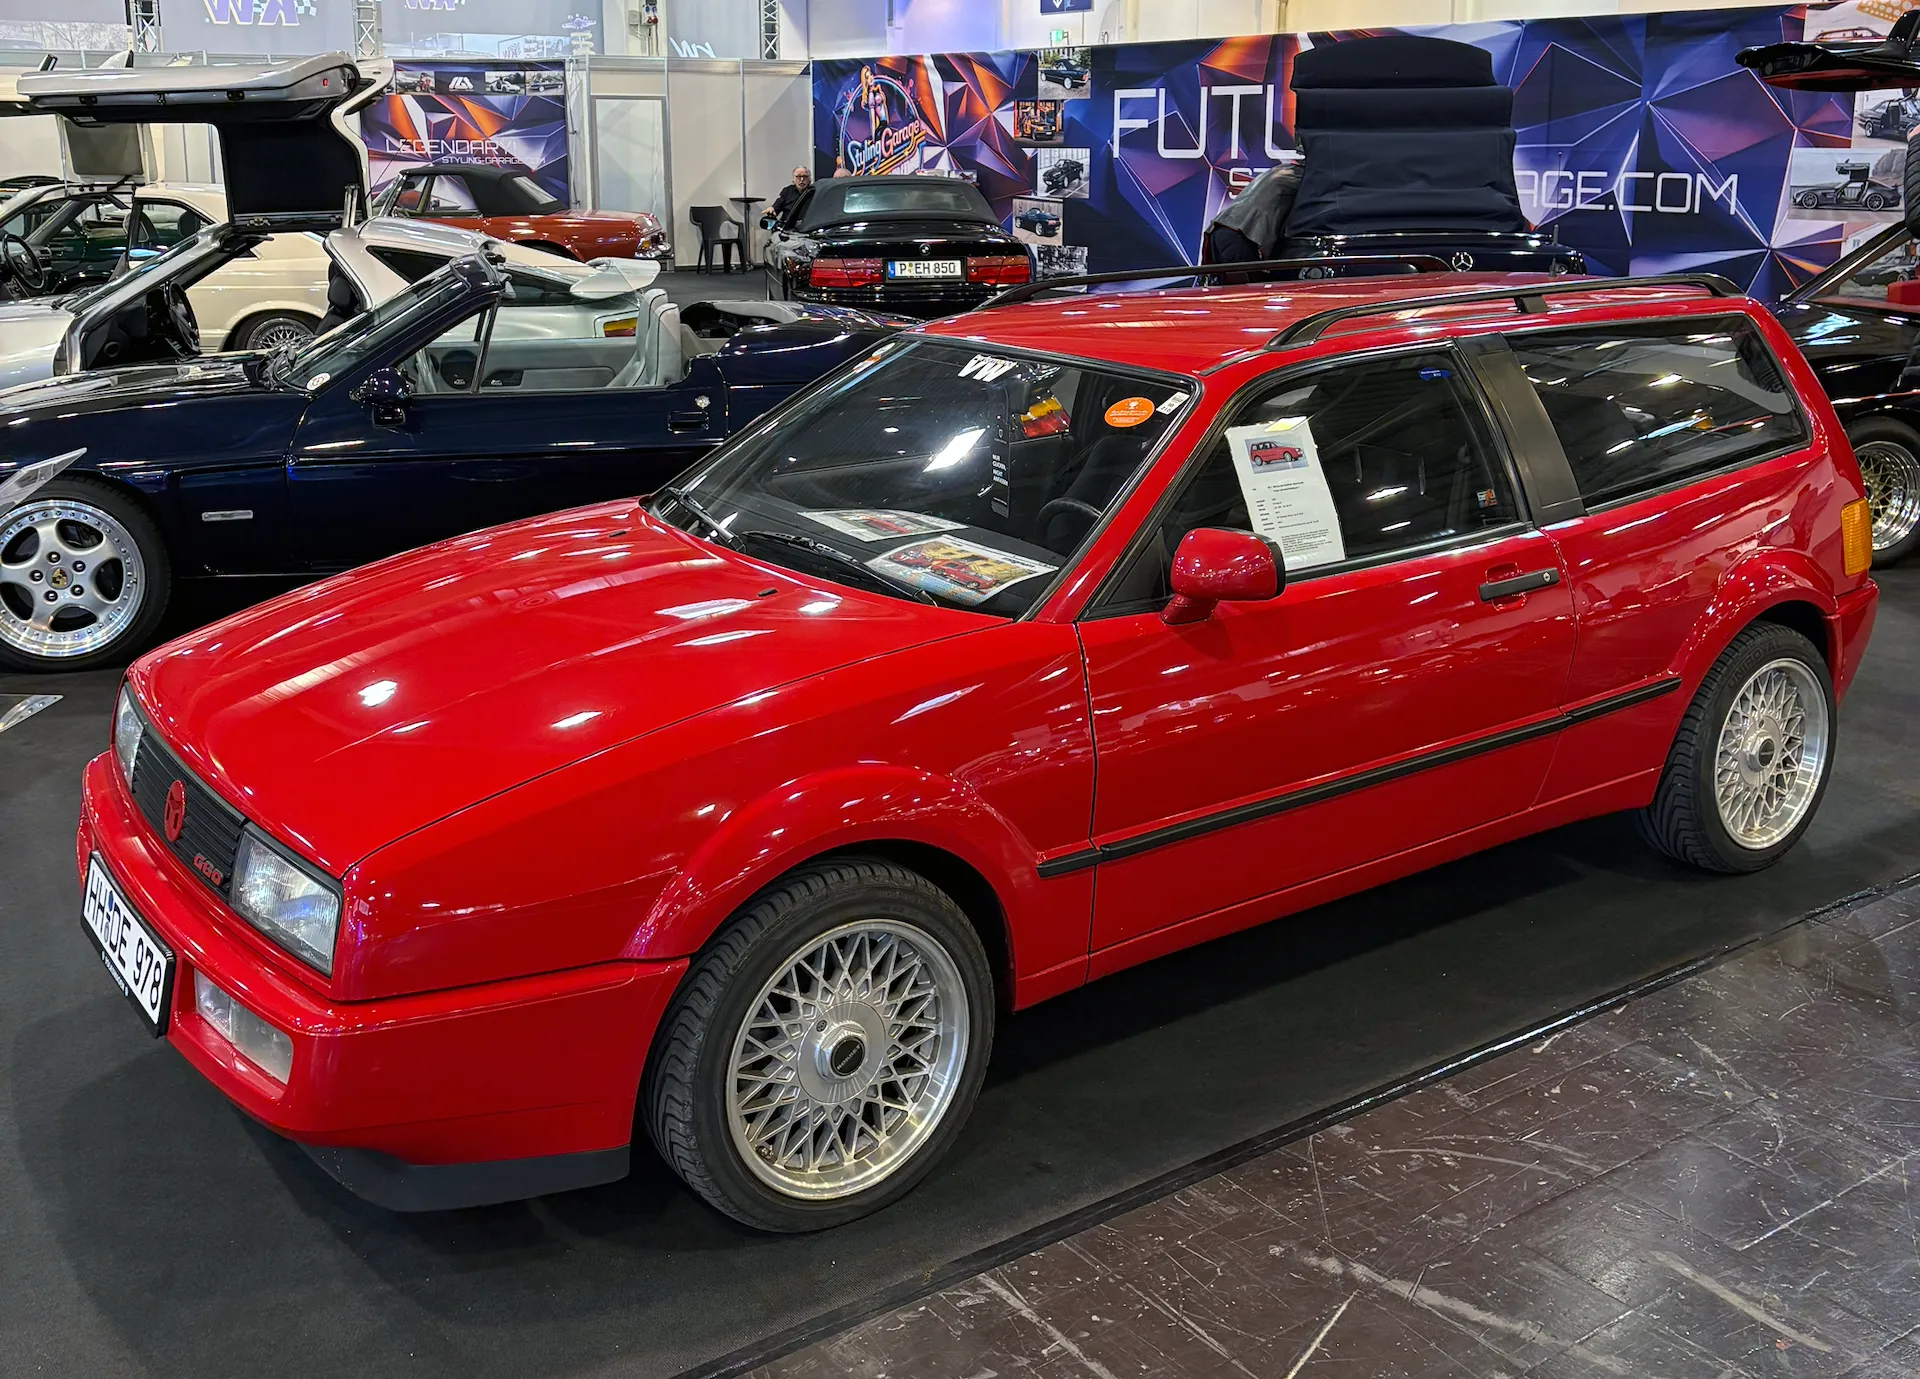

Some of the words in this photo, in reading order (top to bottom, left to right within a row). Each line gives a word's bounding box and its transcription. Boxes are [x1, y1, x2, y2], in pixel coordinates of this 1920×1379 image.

[881, 119, 920, 158] Garage
[899, 262, 907, 275] P
[914, 262, 931, 274] EH
[933, 262, 956, 274] 850
[133, 936, 162, 1011] 978
